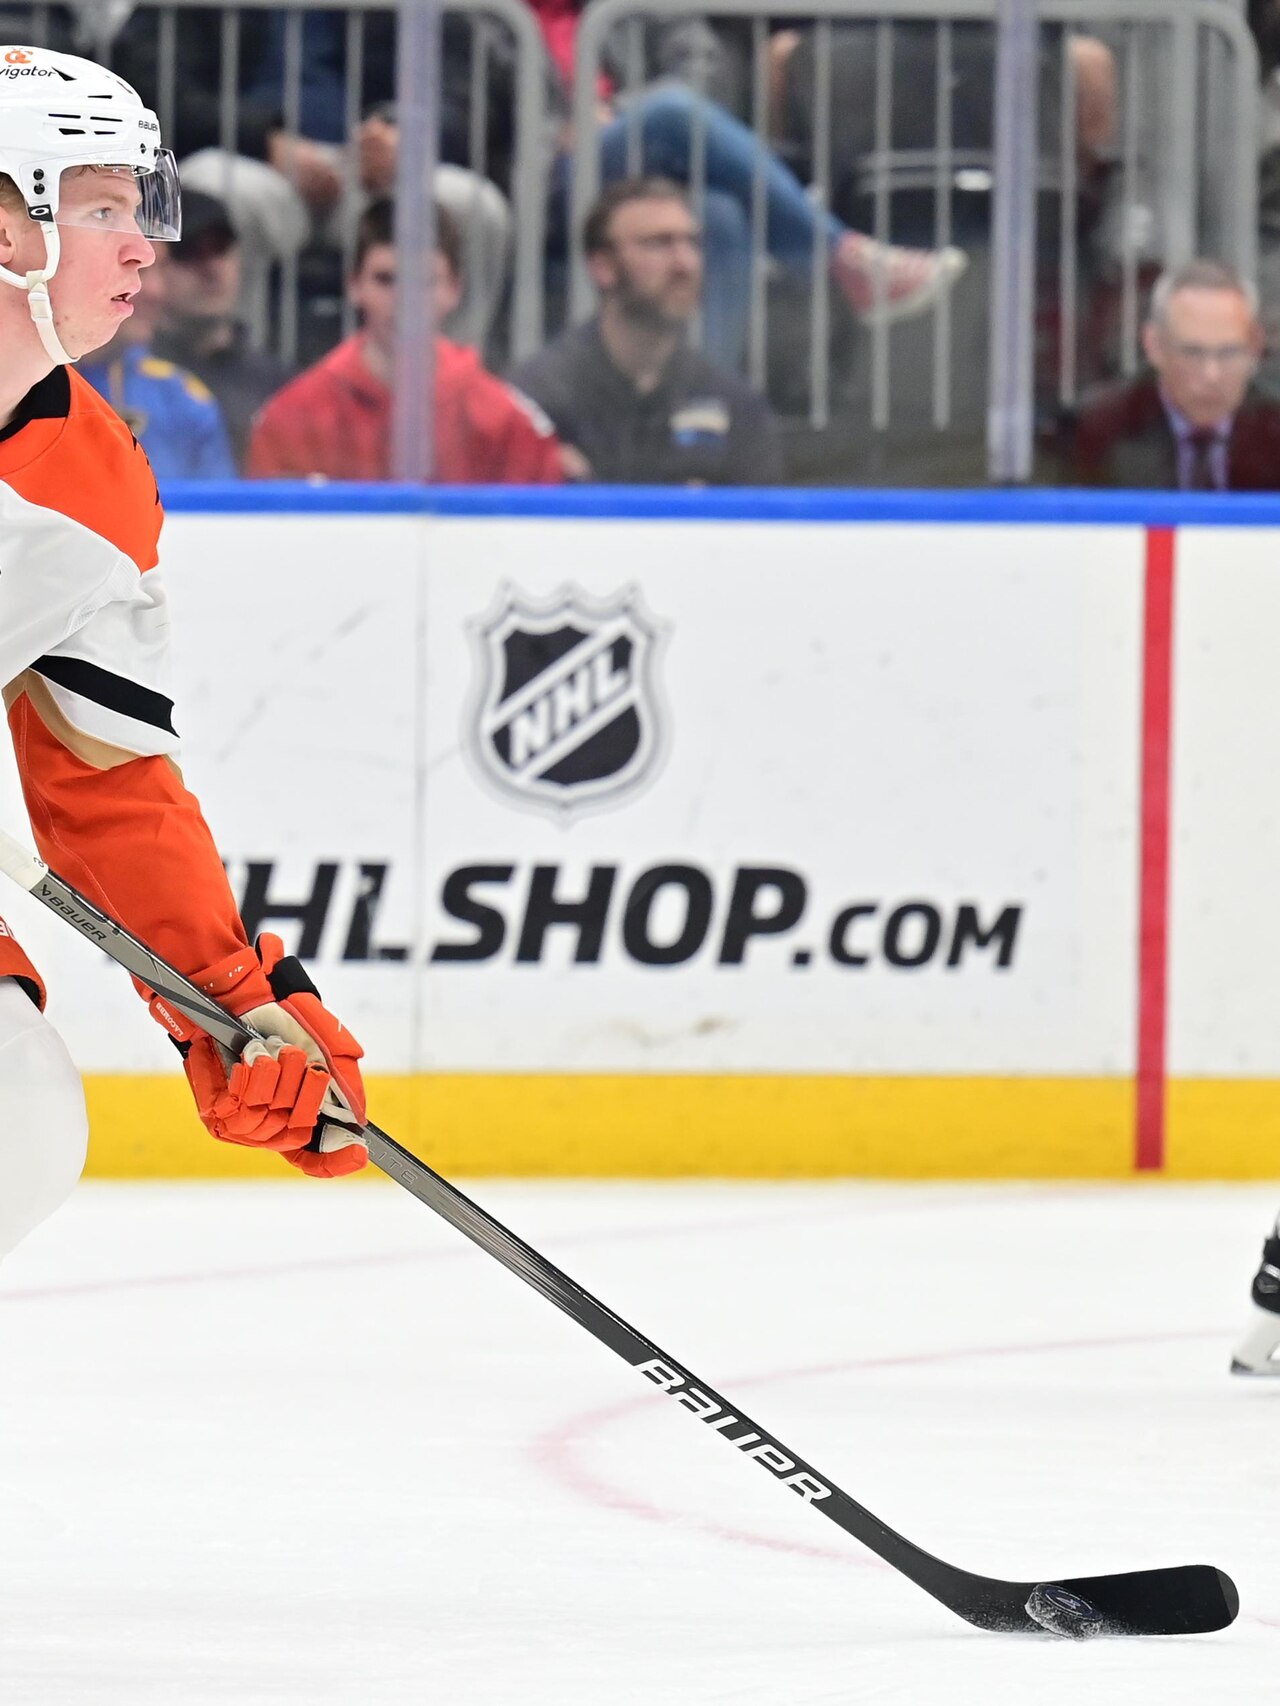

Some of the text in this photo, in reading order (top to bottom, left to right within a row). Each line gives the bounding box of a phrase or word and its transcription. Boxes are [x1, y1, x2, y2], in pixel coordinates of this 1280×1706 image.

[508, 647, 629, 770] NHL
[49, 897, 107, 941] BAUER
[223, 862, 1023, 968] HLSHOP.COM
[633, 1359, 832, 1503] BAUER
